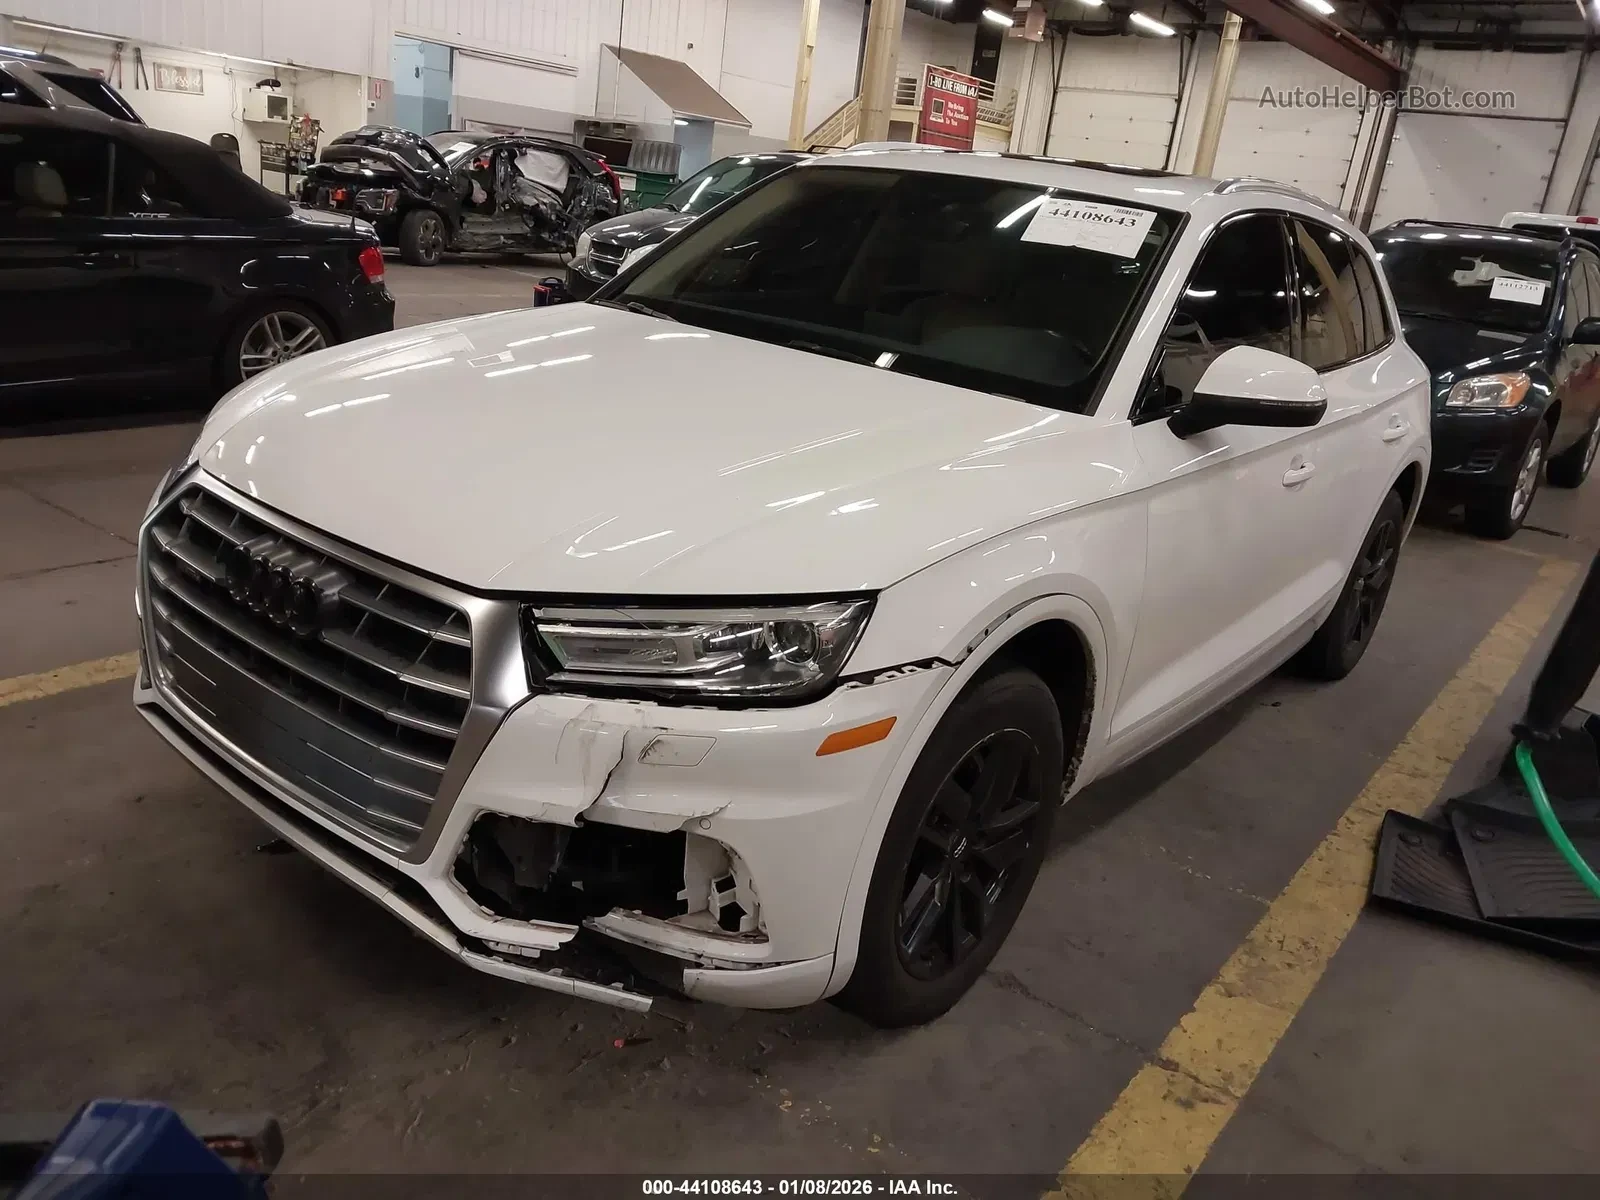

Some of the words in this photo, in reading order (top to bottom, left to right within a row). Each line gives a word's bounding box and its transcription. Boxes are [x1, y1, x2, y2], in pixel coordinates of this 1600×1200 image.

[942, 79, 954, 91] LIVE
[953, 81, 967, 95] FROM
[1048, 208, 1137, 228] 44108643
